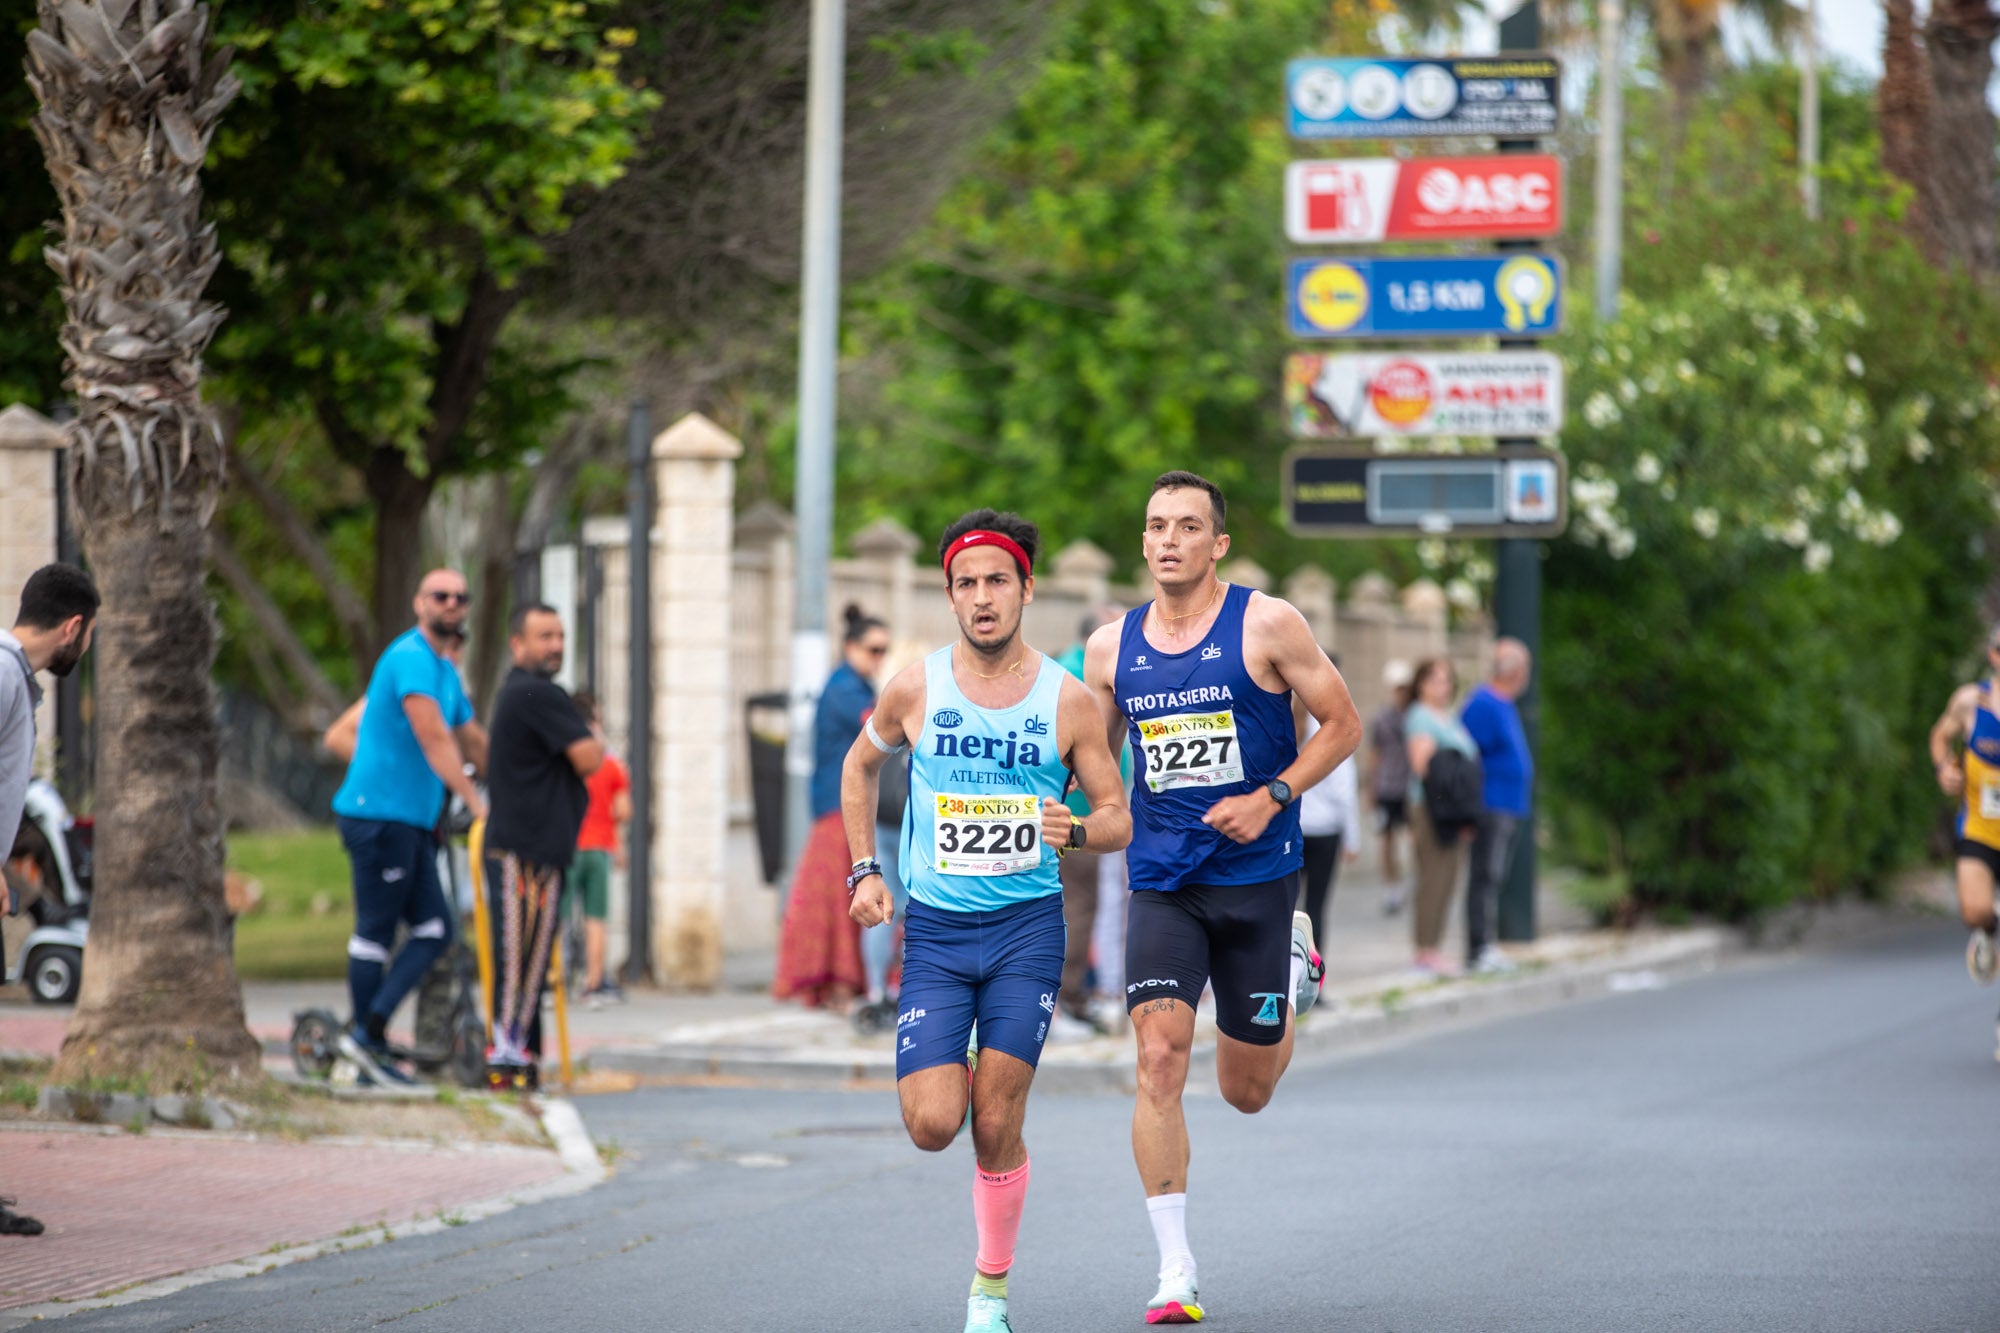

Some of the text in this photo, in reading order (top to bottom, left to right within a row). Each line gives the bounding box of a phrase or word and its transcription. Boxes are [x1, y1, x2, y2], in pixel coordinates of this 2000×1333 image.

[1461, 172, 1551, 213] ASC
[1126, 686, 1233, 713] TROTASIERRA
[935, 712, 962, 725] TROPS
[1151, 722, 1165, 736] 38
[933, 731, 1042, 769] nerja
[1147, 736, 1233, 773] 3227
[949, 769, 1026, 786] ATLETISMO
[949, 799, 964, 813] 38
[964, 804, 1020, 815] FONDO
[939, 822, 1036, 854] 3220
